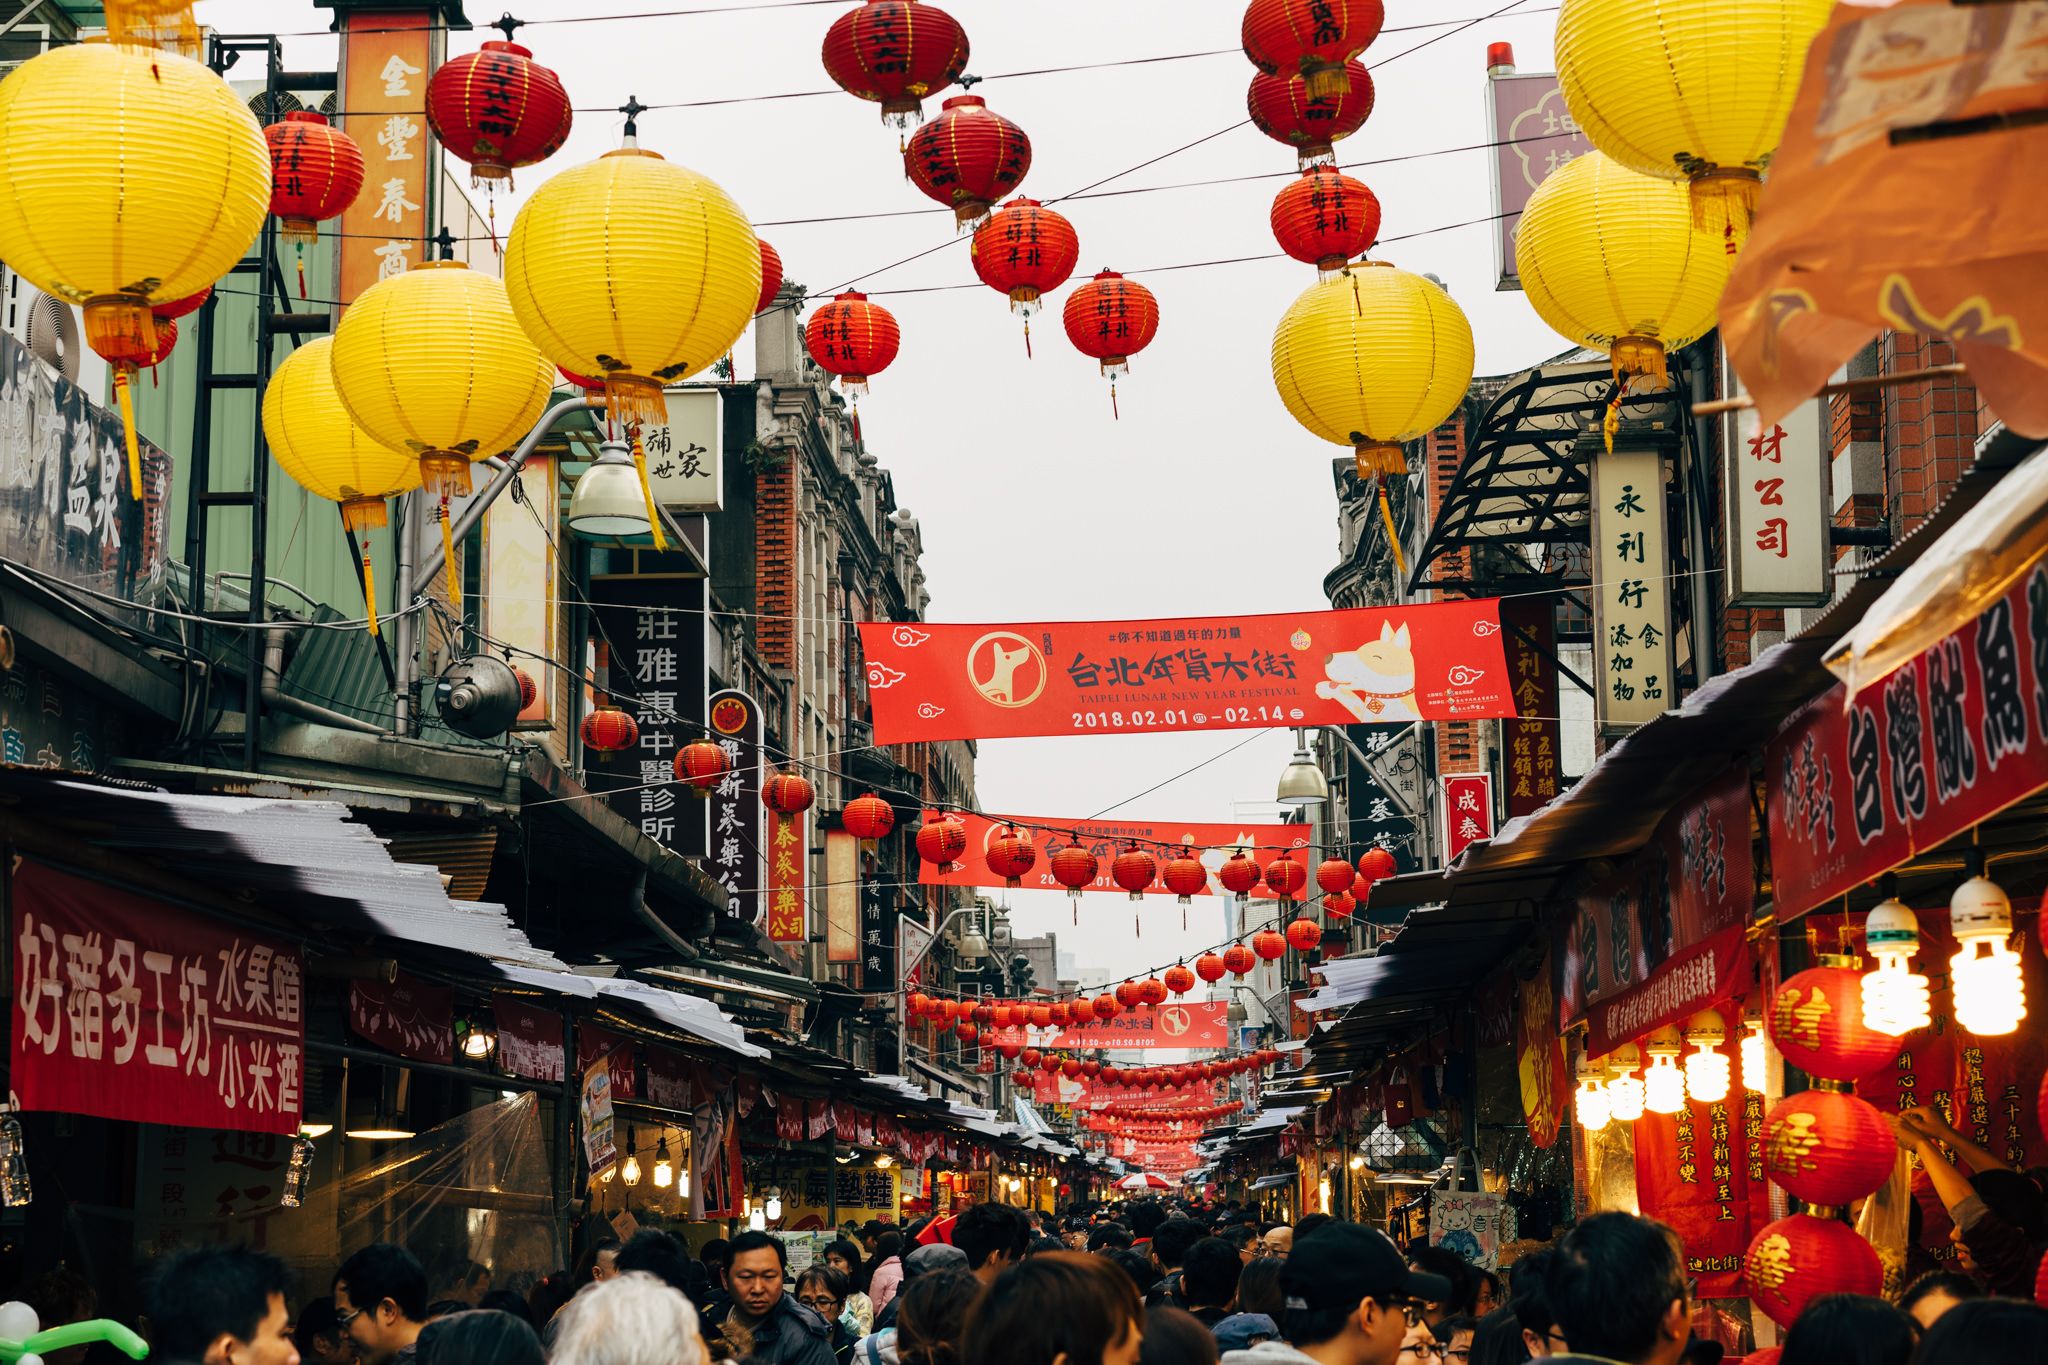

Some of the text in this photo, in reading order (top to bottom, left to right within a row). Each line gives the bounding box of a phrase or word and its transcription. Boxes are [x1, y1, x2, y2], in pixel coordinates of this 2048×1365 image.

[286, 127, 308, 197] 來臺北
[1330, 175, 1350, 232] 來臺北
[1005, 208, 1024, 269] 過好年
[1026, 208, 1043, 267] 來臺北
[821, 304, 838, 362] 過好年
[837, 304, 857, 361] 來臺北
[1096, 281, 1113, 342] 過好年
[1115, 281, 1130, 339] 來臺北
[1747, 422, 1788, 559] 材公司
[1613, 485, 1649, 609] 永利行
[1108, 626, 1242, 644] #你不知道過年的力量
[1609, 623, 1634, 702] 添加物
[1638, 622, 1663, 700] 食品
[1067, 648, 1298, 689] 台北年貨大街
[1078, 687, 1301, 704] TAIPEI LUNAR NEW YEAR FESTIVAL
[635, 605, 679, 843] 莊雅惠中醫診所
[1071, 709, 1188, 728] 2018.02.01
[1512, 736, 1534, 798] 經銷處
[1537, 736, 1555, 797] 五印醋
[1456, 789, 1481, 840] 成泰
[866, 879, 882, 973] 愛情萬歲
[216, 937, 300, 1023] 水果醋
[218, 1034, 299, 1113] 小米酒
[1963, 1048, 1990, 1151] 認真嚴選品
[1708, 1102, 1736, 1222] 堅持新鮮至上
